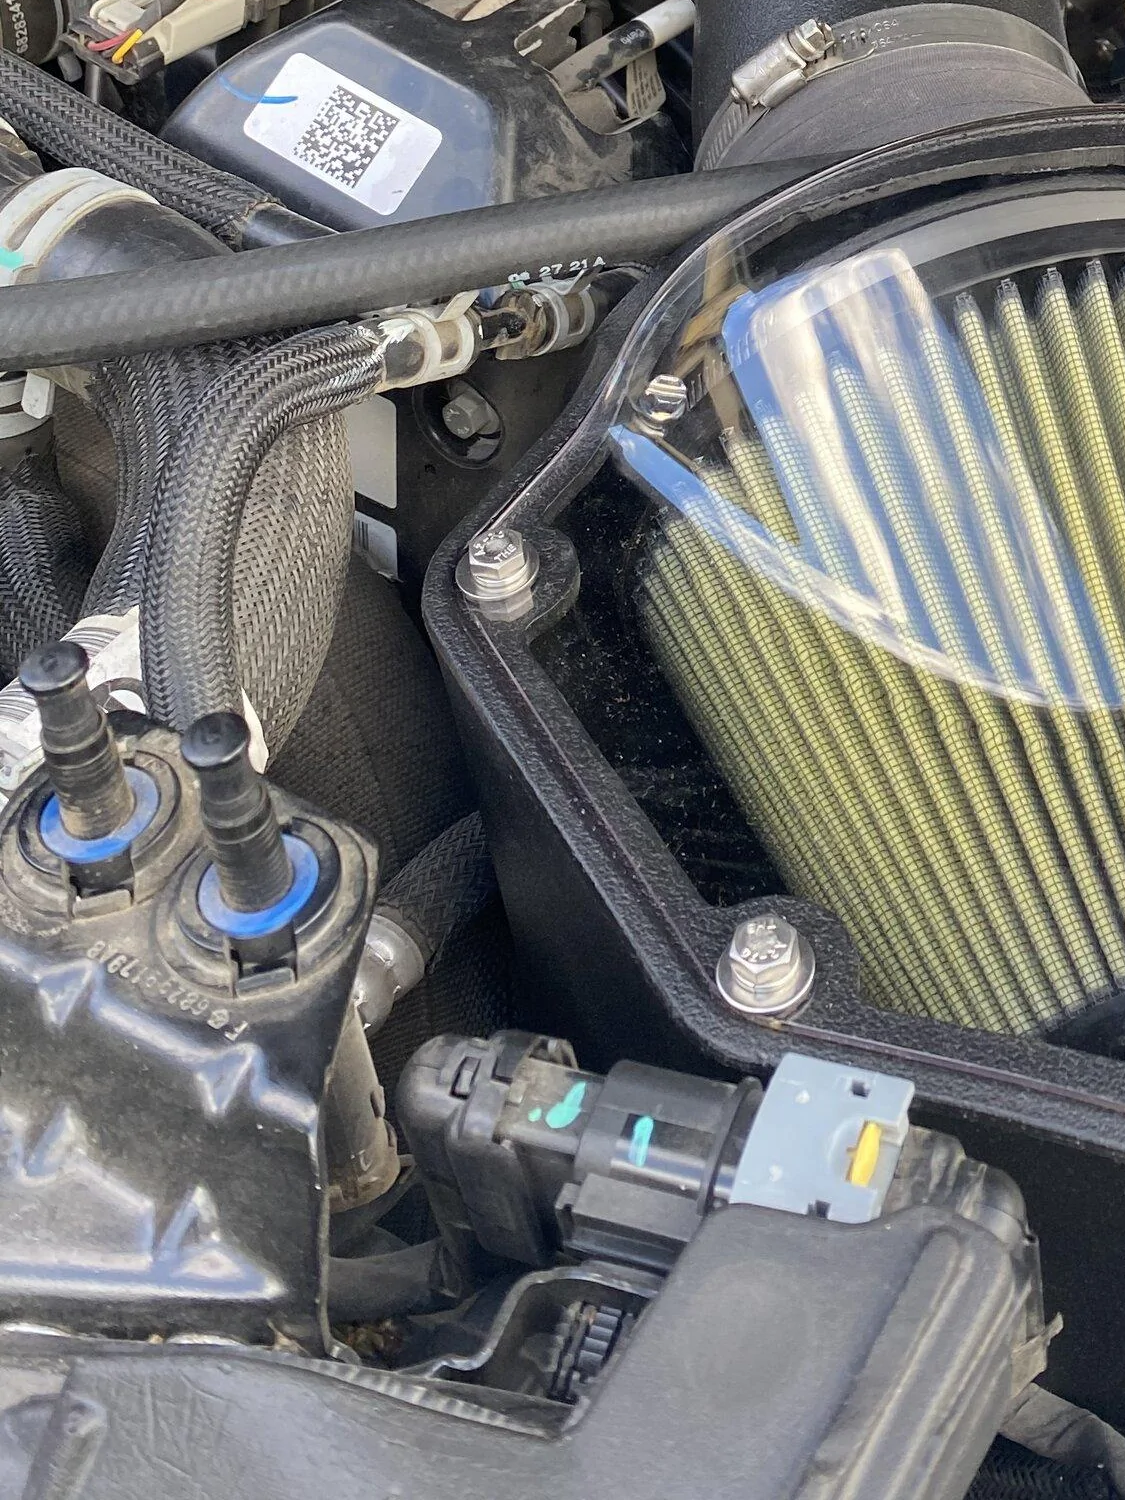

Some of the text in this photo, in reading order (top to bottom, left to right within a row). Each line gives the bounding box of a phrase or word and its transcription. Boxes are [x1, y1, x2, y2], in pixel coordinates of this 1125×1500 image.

[539, 263, 563, 278] 27
[569, 258, 588, 272] 21
[493, 543, 517, 562] THE
